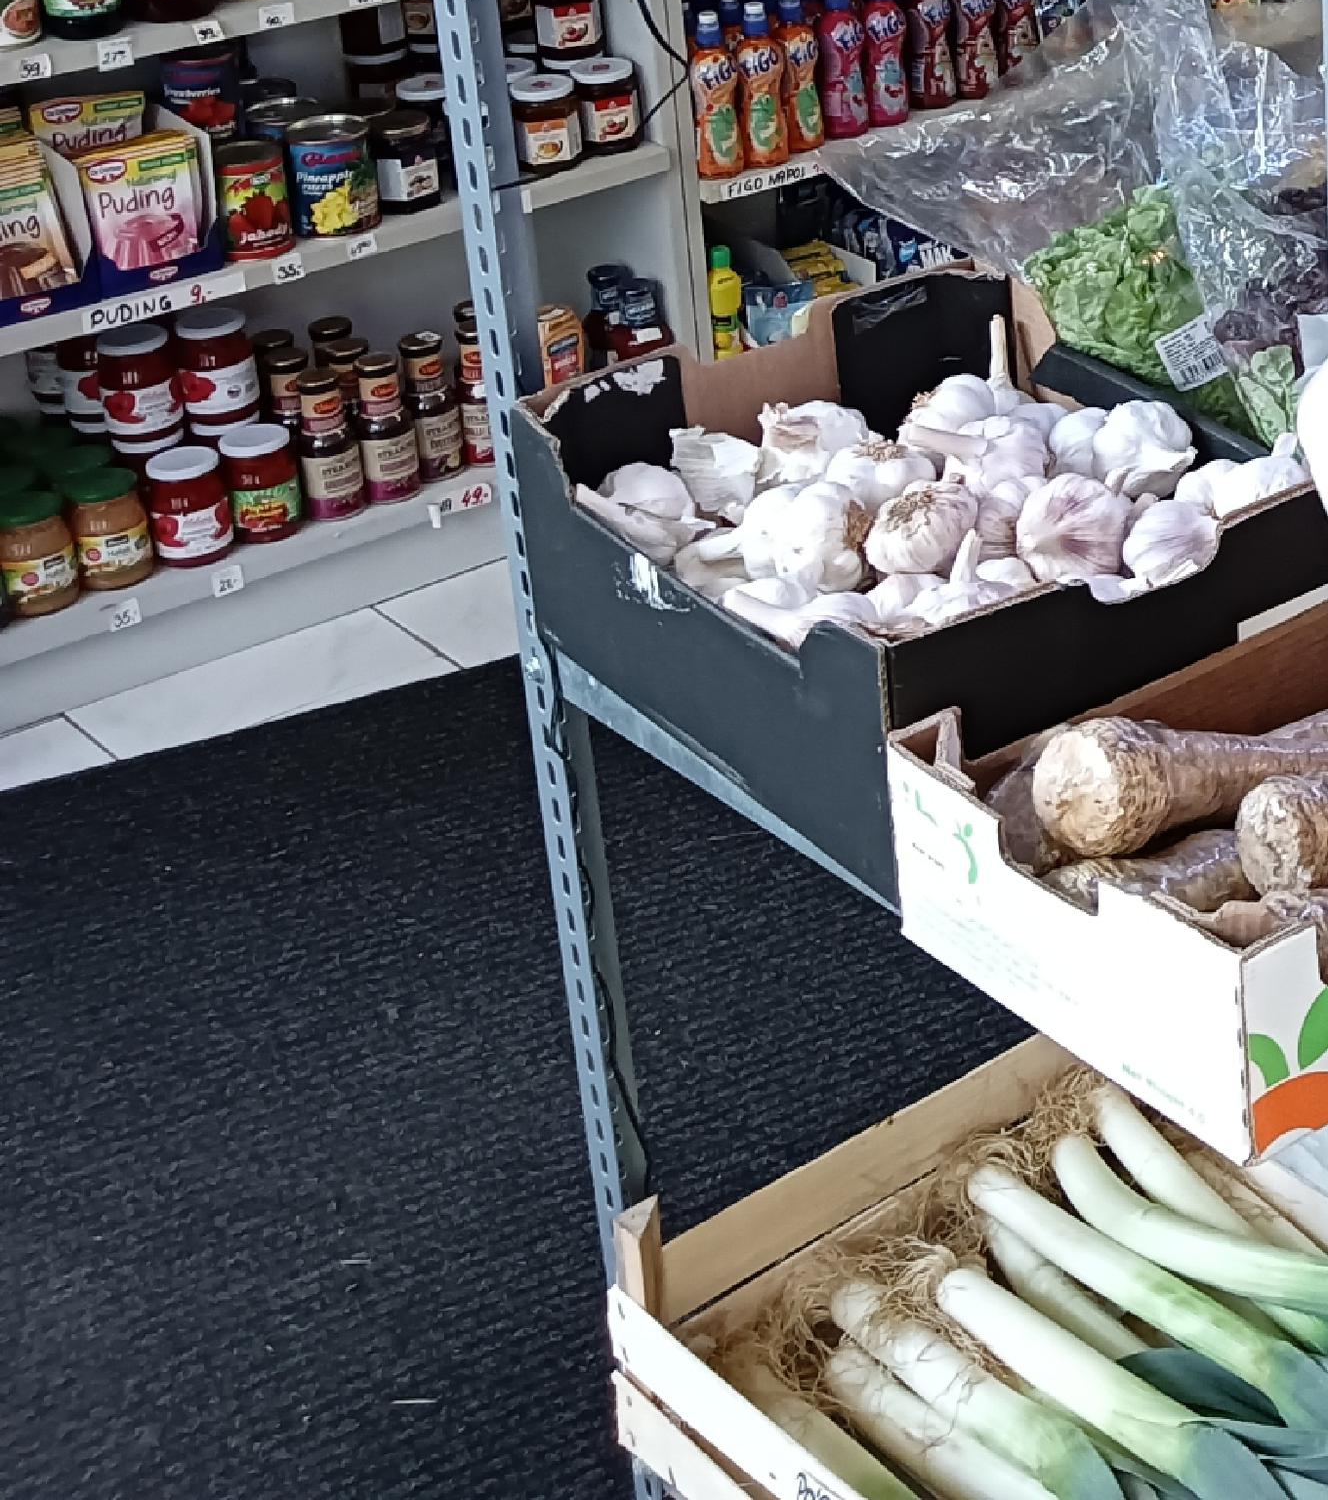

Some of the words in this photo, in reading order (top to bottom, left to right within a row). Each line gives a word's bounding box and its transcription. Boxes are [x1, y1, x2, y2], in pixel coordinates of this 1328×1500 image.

[52, 121, 129, 151] Puding
[99, 184, 175, 219] Puding
[89, 296, 173, 326] PUDING
